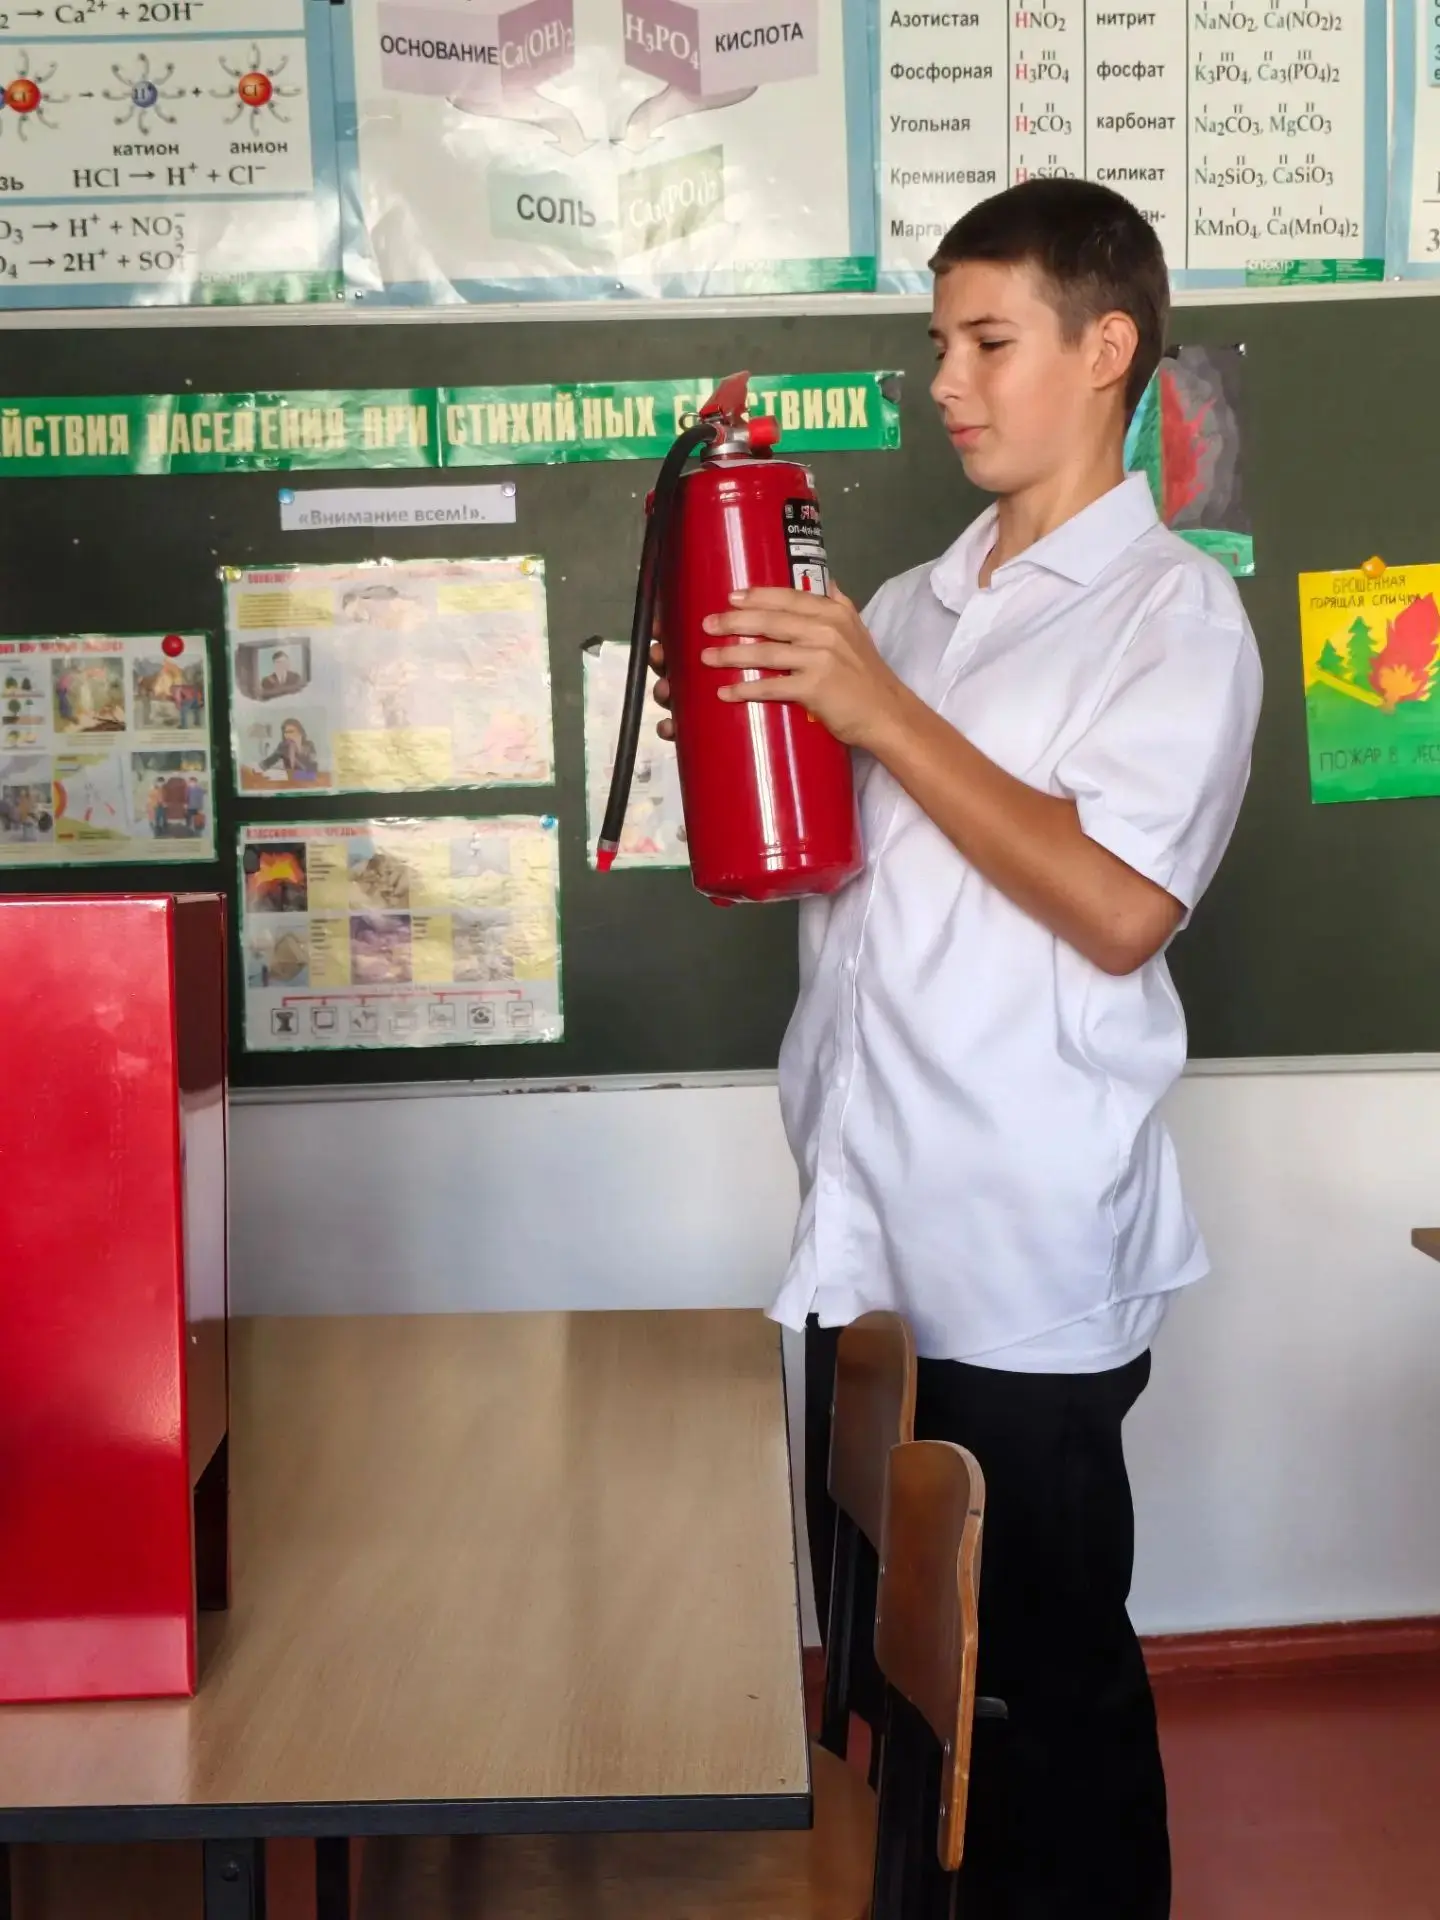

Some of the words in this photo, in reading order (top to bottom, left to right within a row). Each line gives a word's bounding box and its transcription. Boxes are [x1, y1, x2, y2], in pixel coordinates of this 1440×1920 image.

[890, 10, 979, 28] Азотистая
[1096, 12, 1156, 29] нитрит
[715, 22, 804, 53] КИСЛОТА
[380, 34, 499, 66] ОСНОВАНИЕ
[890, 62, 993, 83] Фосфорная
[1096, 61, 1165, 81] фосфат
[890, 115, 971, 133] Угольная
[1096, 112, 1176, 130] карбонат
[113, 143, 179, 156] катион
[230, 142, 288, 154] анион
[73, 168, 120, 188] HCl
[890, 168, 996, 189] Кремниевая
[1096, 167, 1165, 181] силикат
[516, 193, 597, 228] СОЛЬ
[1, 409, 128, 457] ЙСТВИЯ
[446, 394, 656, 446] СТИХИЙНЫХ
[299, 509, 409, 526] «Внимание
[1319, 746, 1382, 772] ПОЖАР
[1413, 744, 1440, 764] ЛЕС
